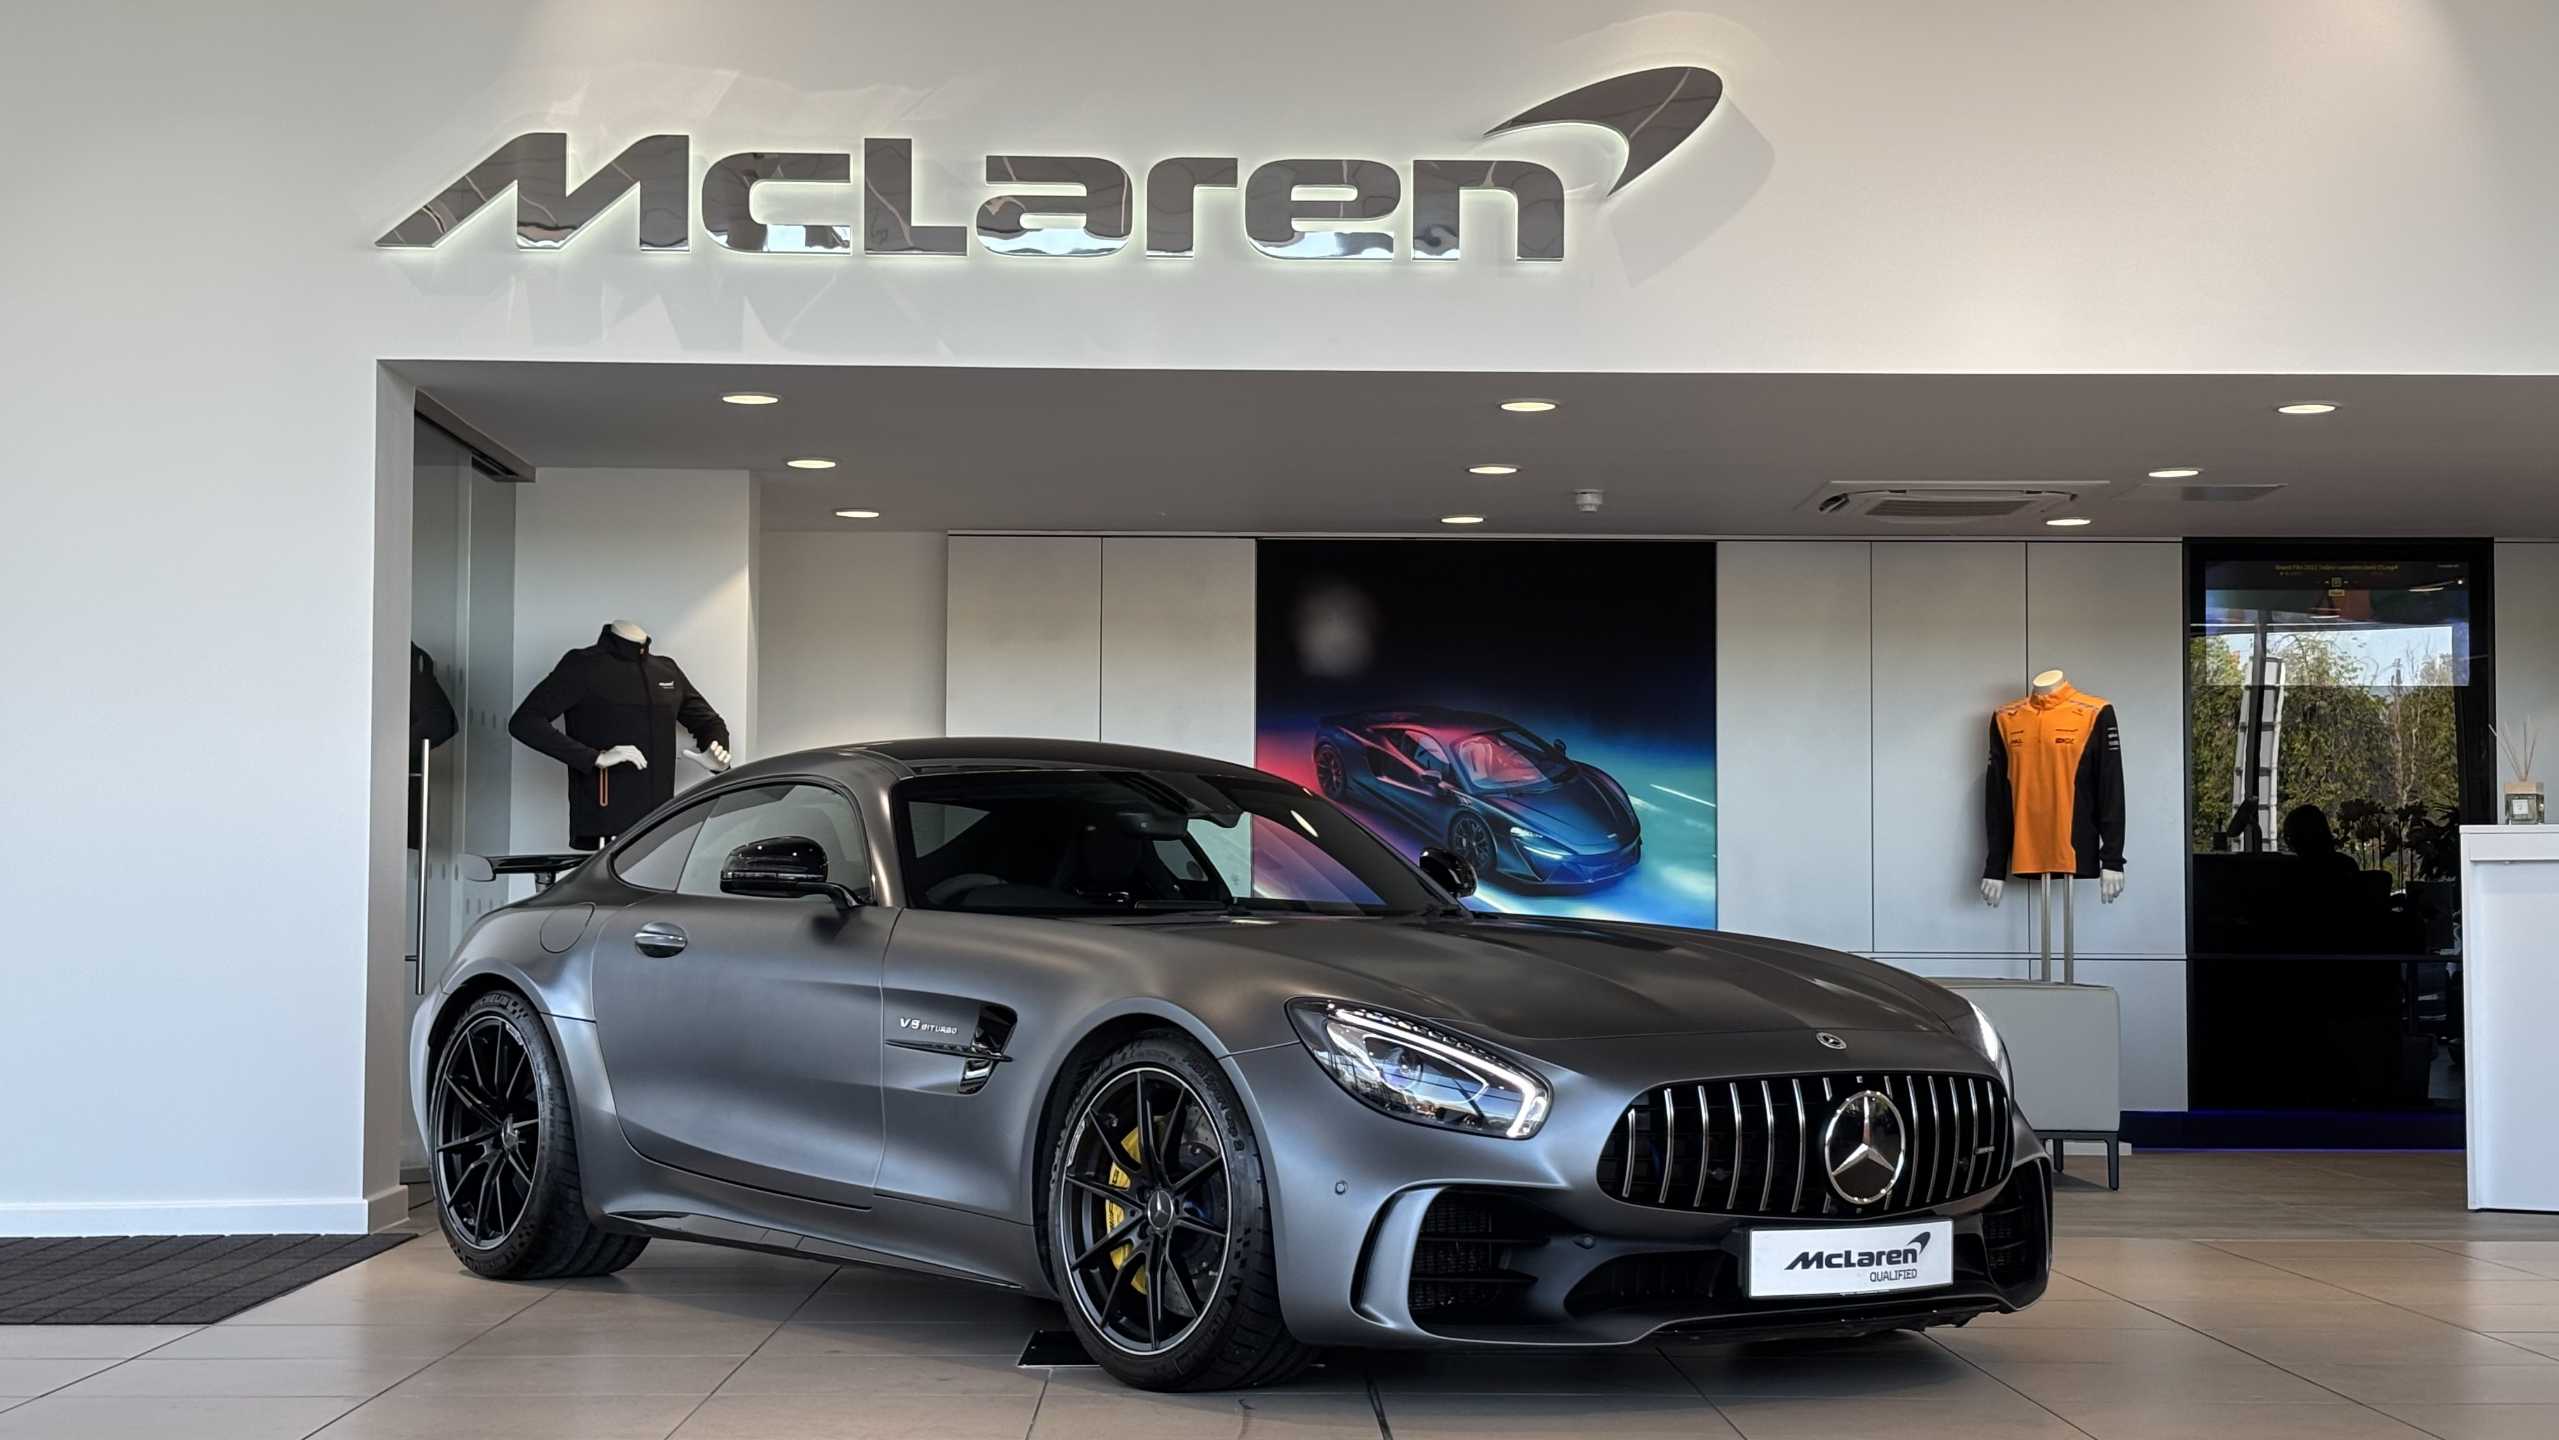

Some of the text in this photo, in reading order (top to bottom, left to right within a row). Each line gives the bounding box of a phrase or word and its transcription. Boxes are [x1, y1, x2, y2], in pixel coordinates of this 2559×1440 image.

[375, 131, 1566, 262] McLaren
[1784, 1248, 1918, 1270] McLaren
[1869, 1268, 1918, 1282] QUALIFIED
